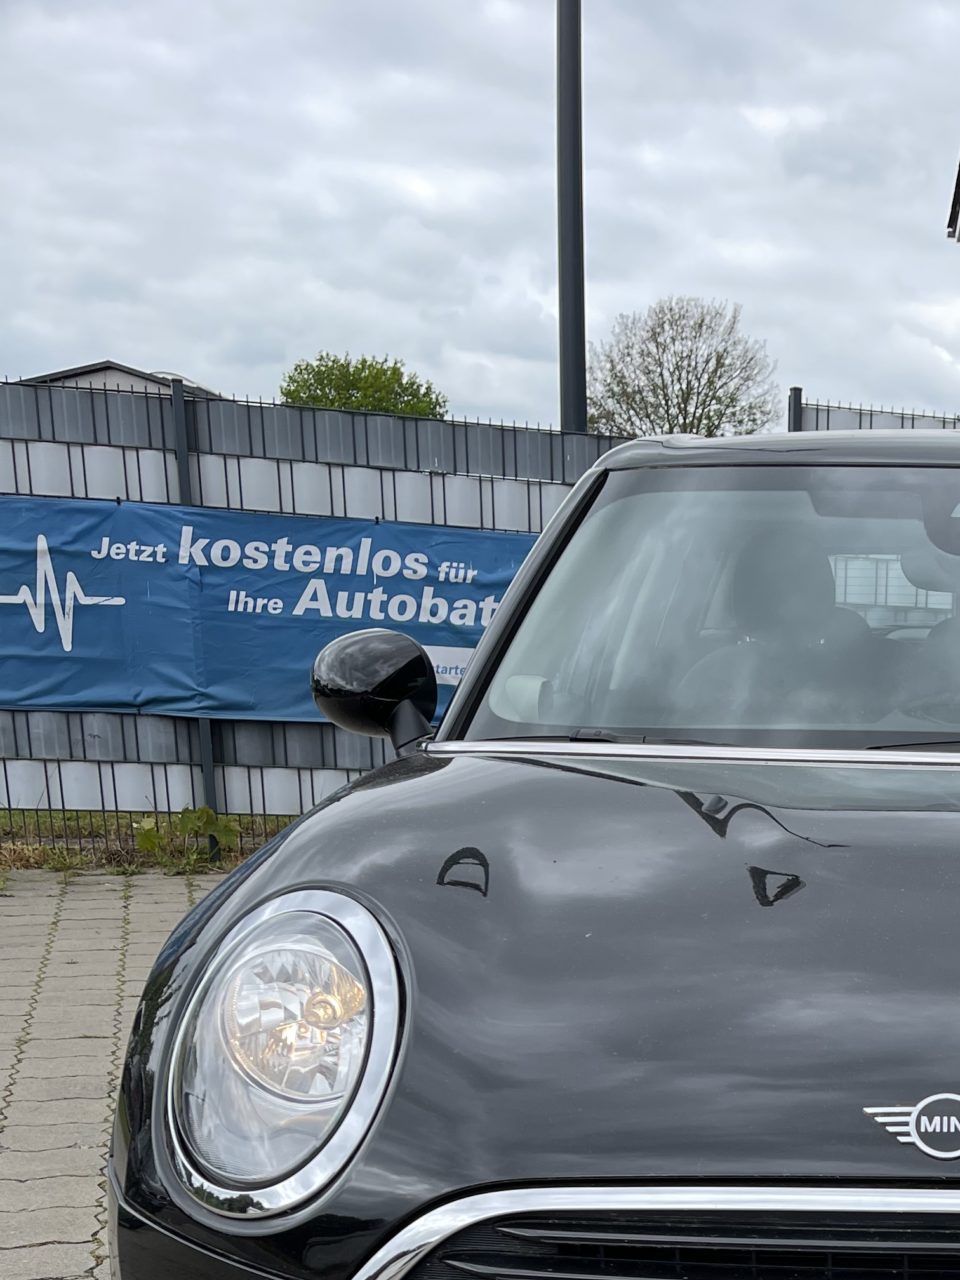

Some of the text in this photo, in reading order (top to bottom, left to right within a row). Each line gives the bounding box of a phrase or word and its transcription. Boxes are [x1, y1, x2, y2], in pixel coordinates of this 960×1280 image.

[91, 525, 478, 584] Jetzt kostenlos für
[227, 590, 284, 614] Ihre
[433, 665, 466, 676] tarte
